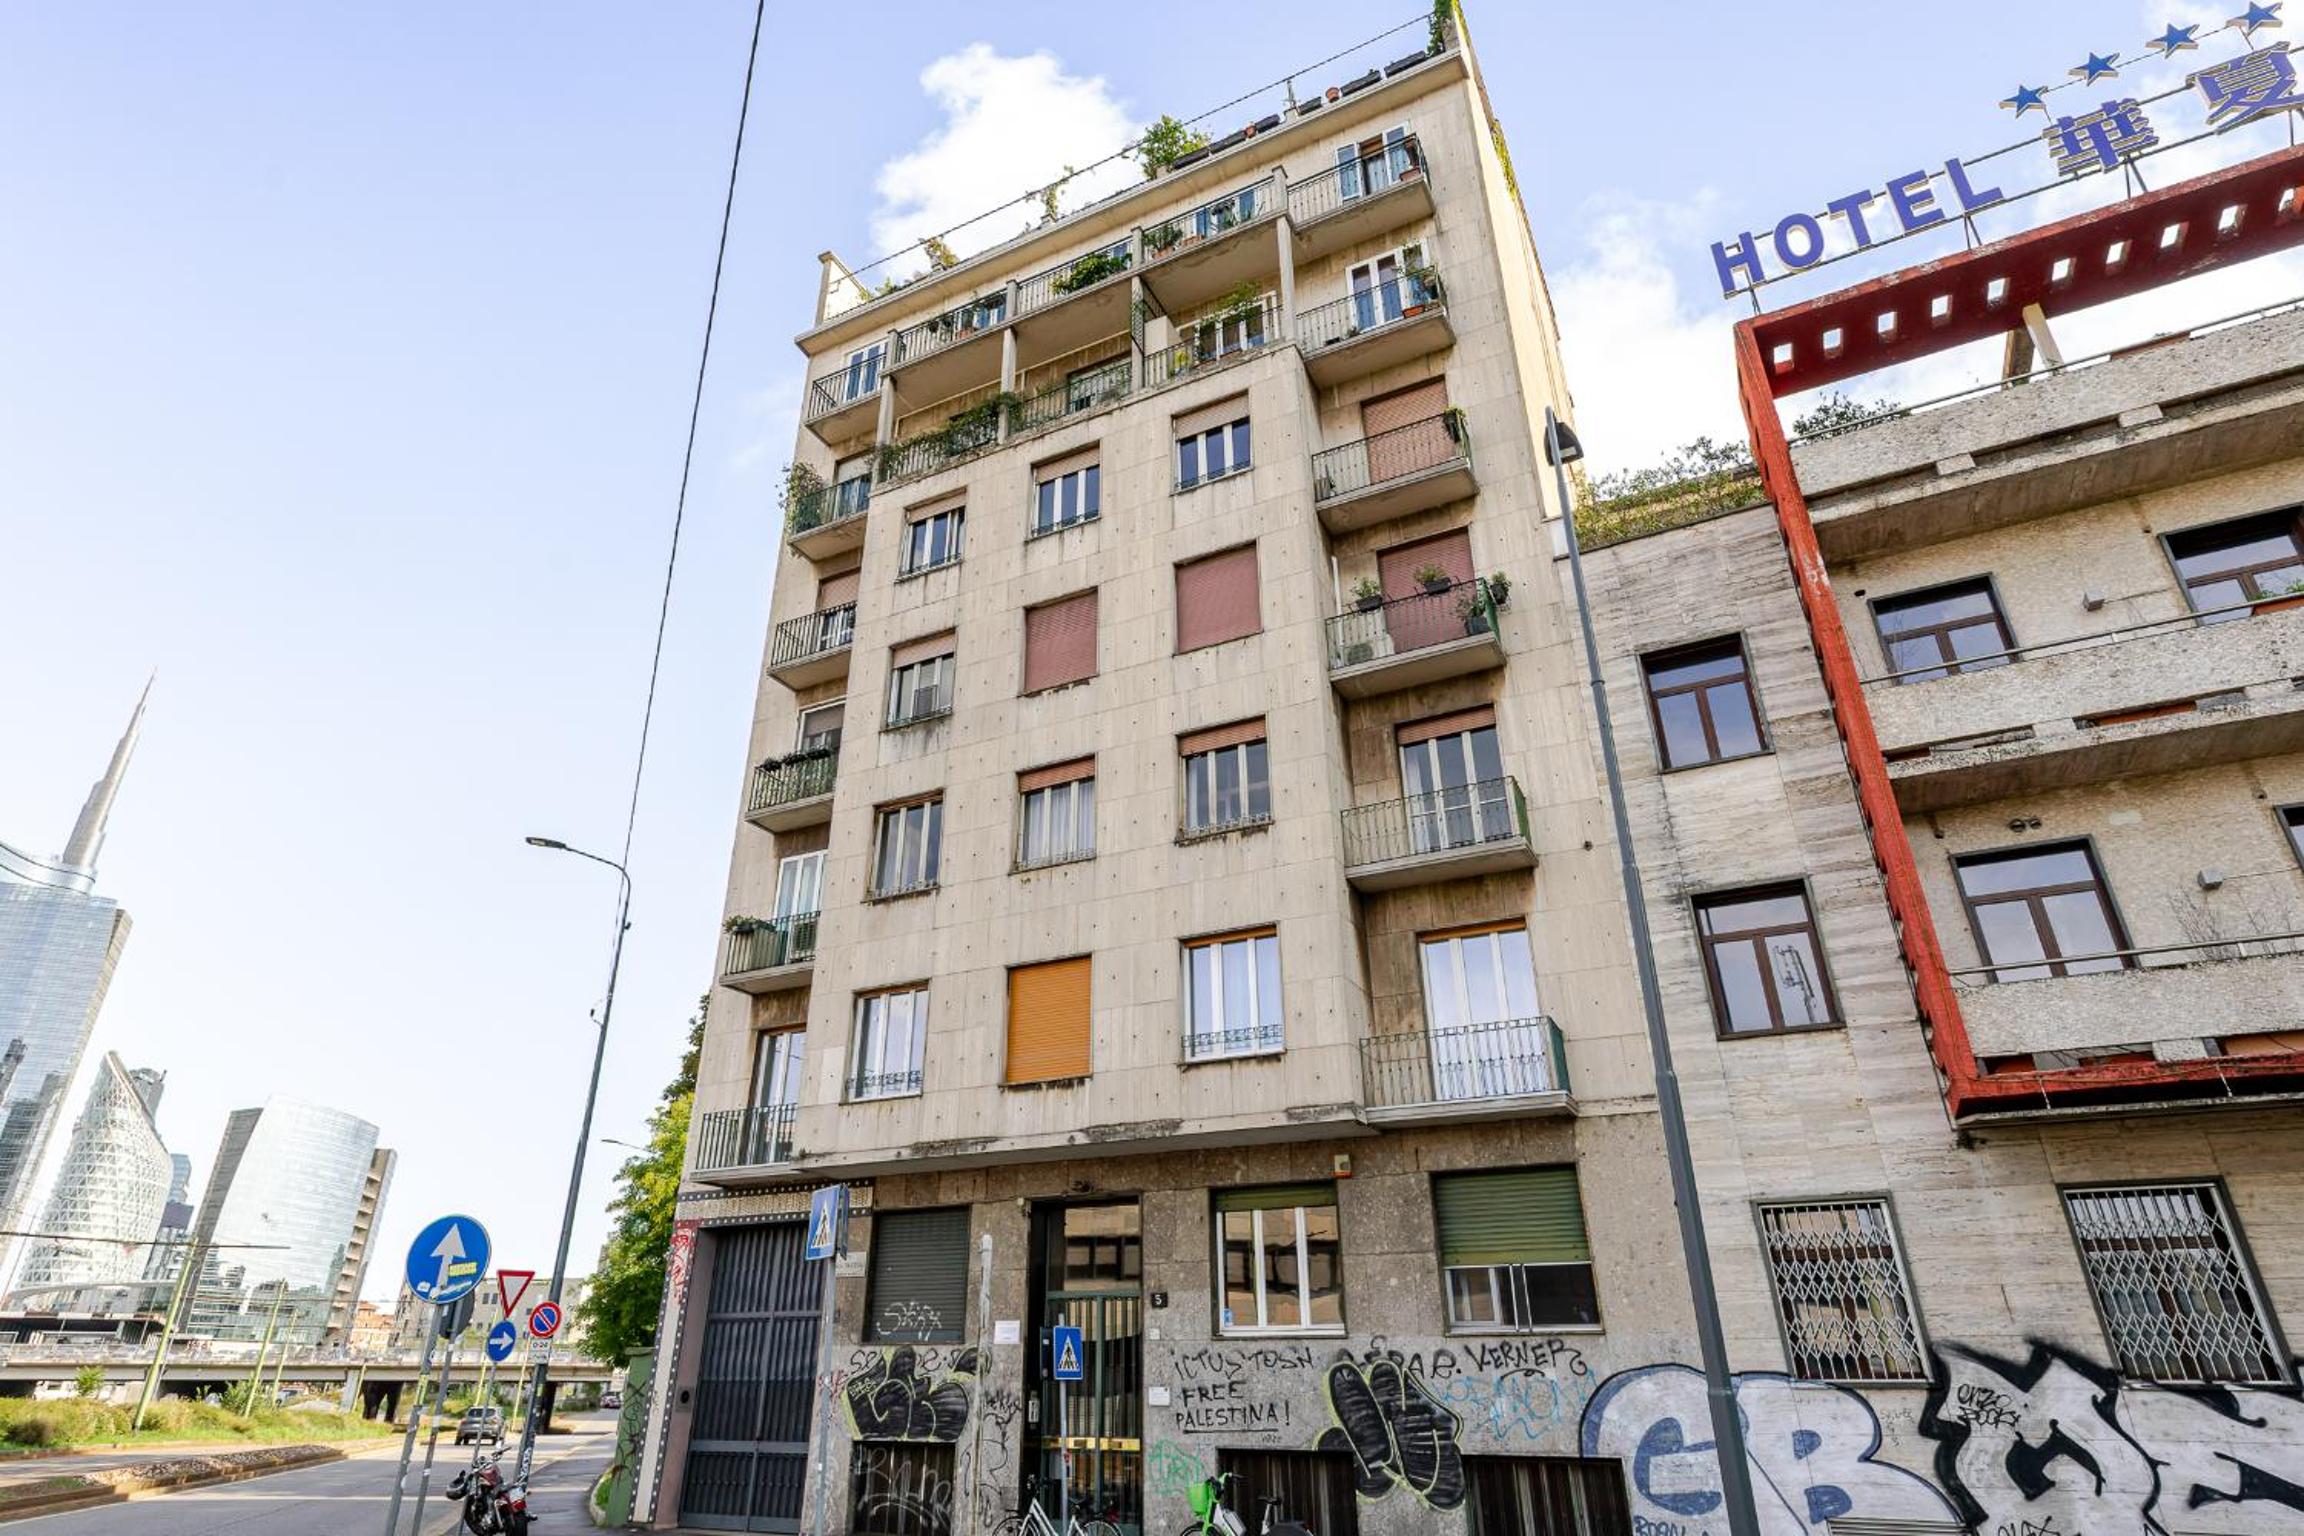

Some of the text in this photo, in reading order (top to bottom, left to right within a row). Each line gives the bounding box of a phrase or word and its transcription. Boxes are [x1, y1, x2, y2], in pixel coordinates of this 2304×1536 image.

[1710, 157, 2004, 297] HOTEL
[1155, 1294, 1162, 1305] 5
[1463, 1339, 1588, 1376] VERNER
[1182, 1380, 1247, 1407] FREE
[1176, 1400, 1290, 1430] PALESTINA!
